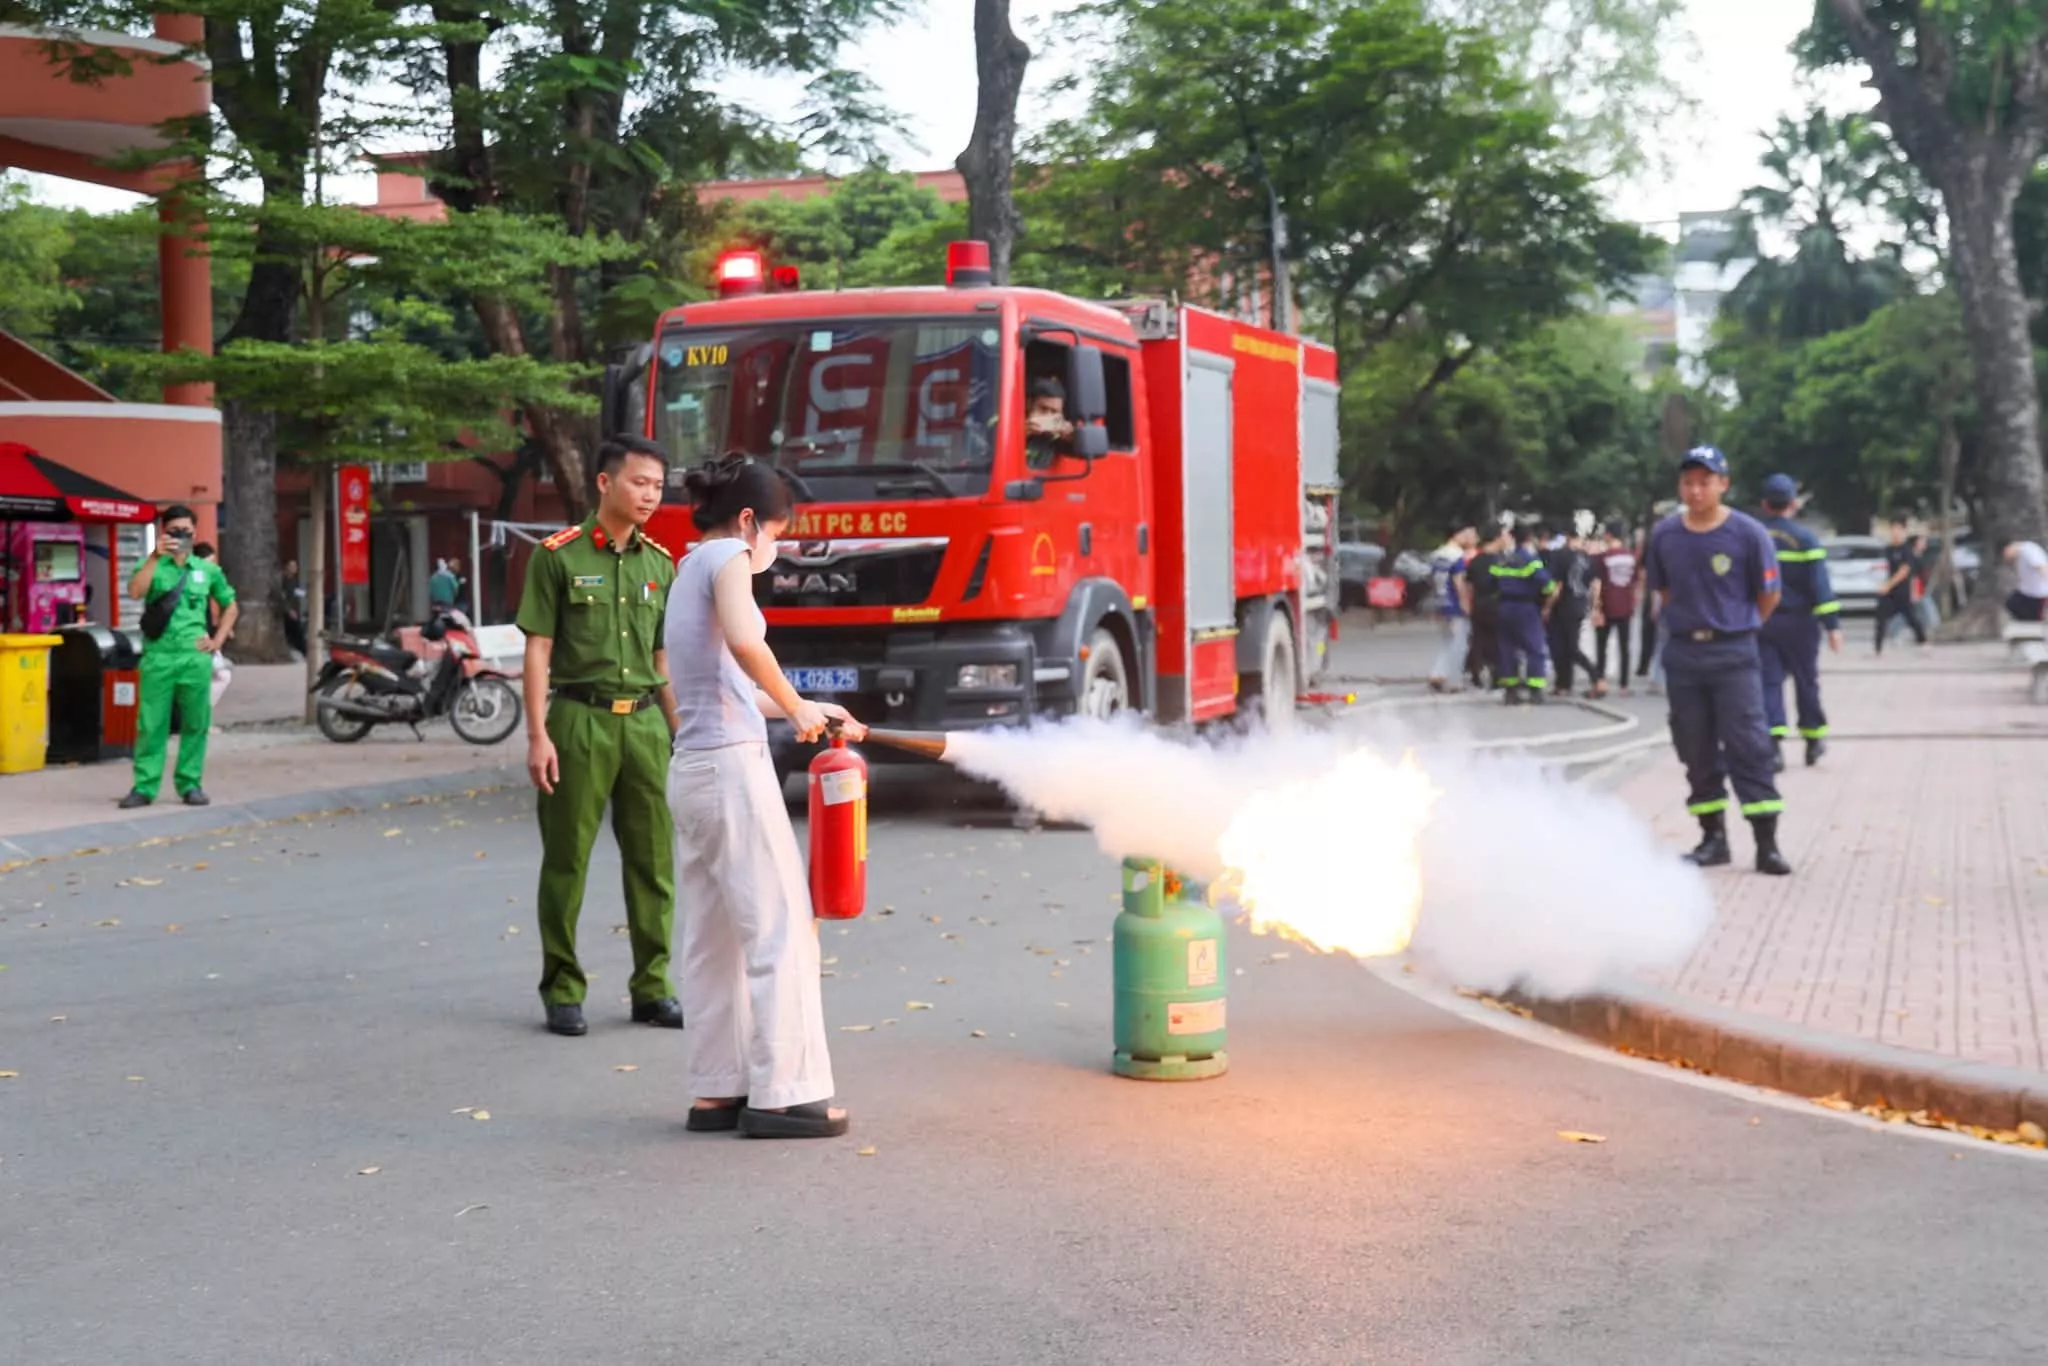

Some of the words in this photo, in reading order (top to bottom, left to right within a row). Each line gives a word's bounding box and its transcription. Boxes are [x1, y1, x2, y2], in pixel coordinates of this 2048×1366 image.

[687, 345, 728, 366] KV10
[826, 513, 853, 534] PC
[859, 513, 874, 533] &
[879, 511, 907, 533] CC
[773, 573, 857, 593] MAN
